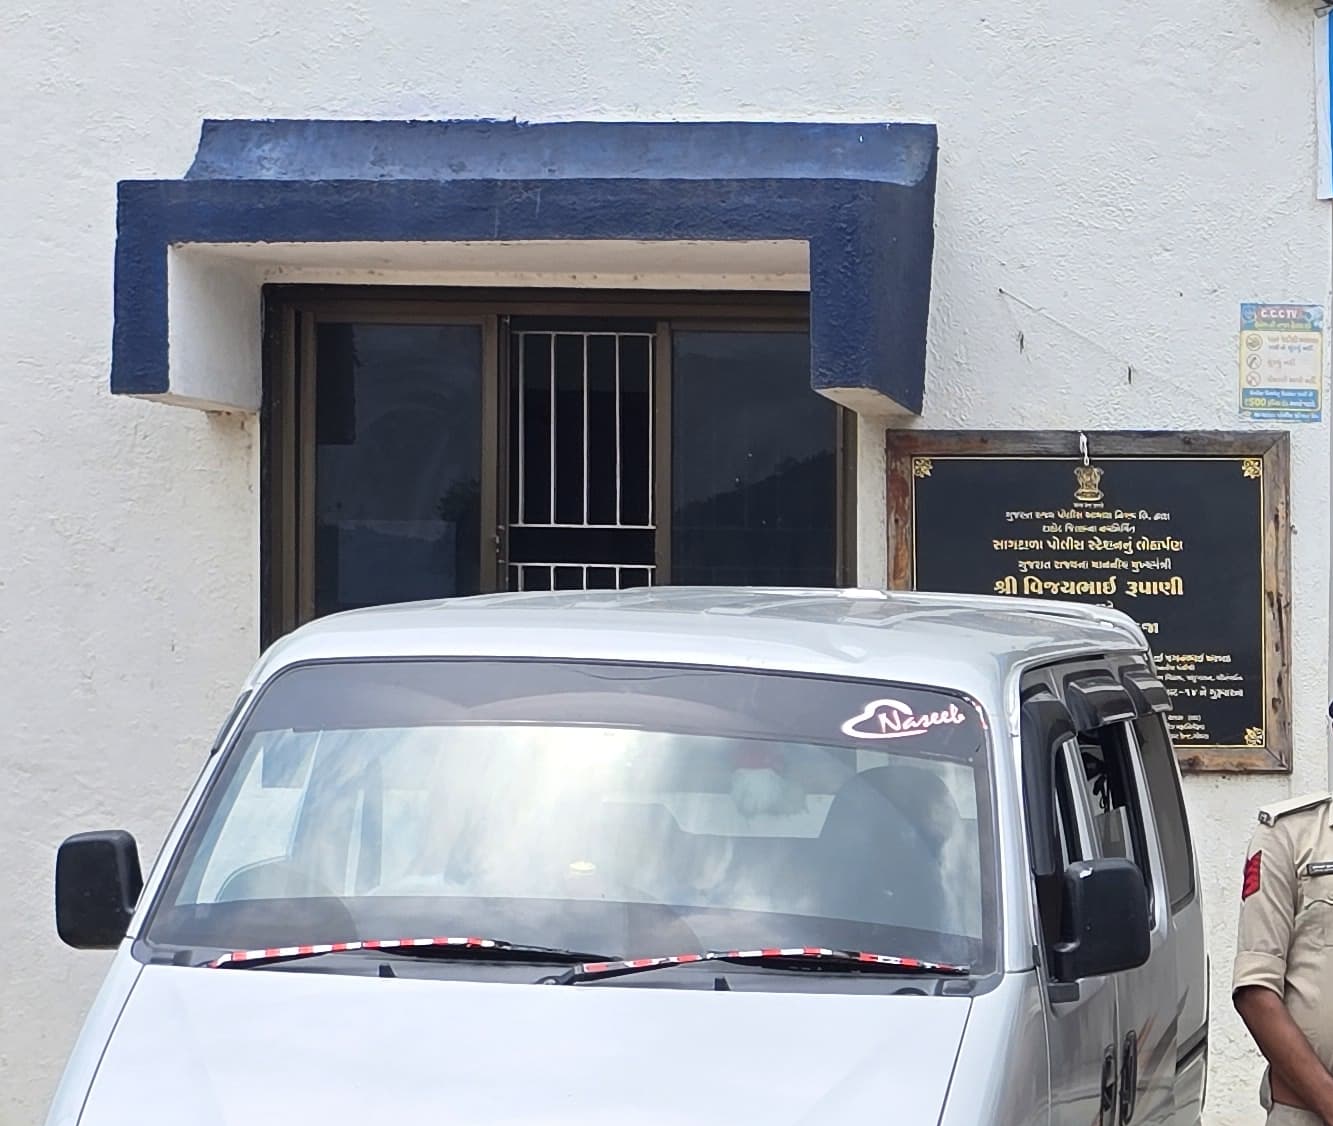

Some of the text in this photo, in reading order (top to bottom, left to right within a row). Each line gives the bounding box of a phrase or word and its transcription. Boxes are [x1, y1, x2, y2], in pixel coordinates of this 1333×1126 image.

[1046, 535, 1085, 551] પોલીસ
[993, 575, 1018, 595] શ્રી
[1124, 575, 1185, 597] રૂપાણી
[878, 703, 966, 734] Naseeb
